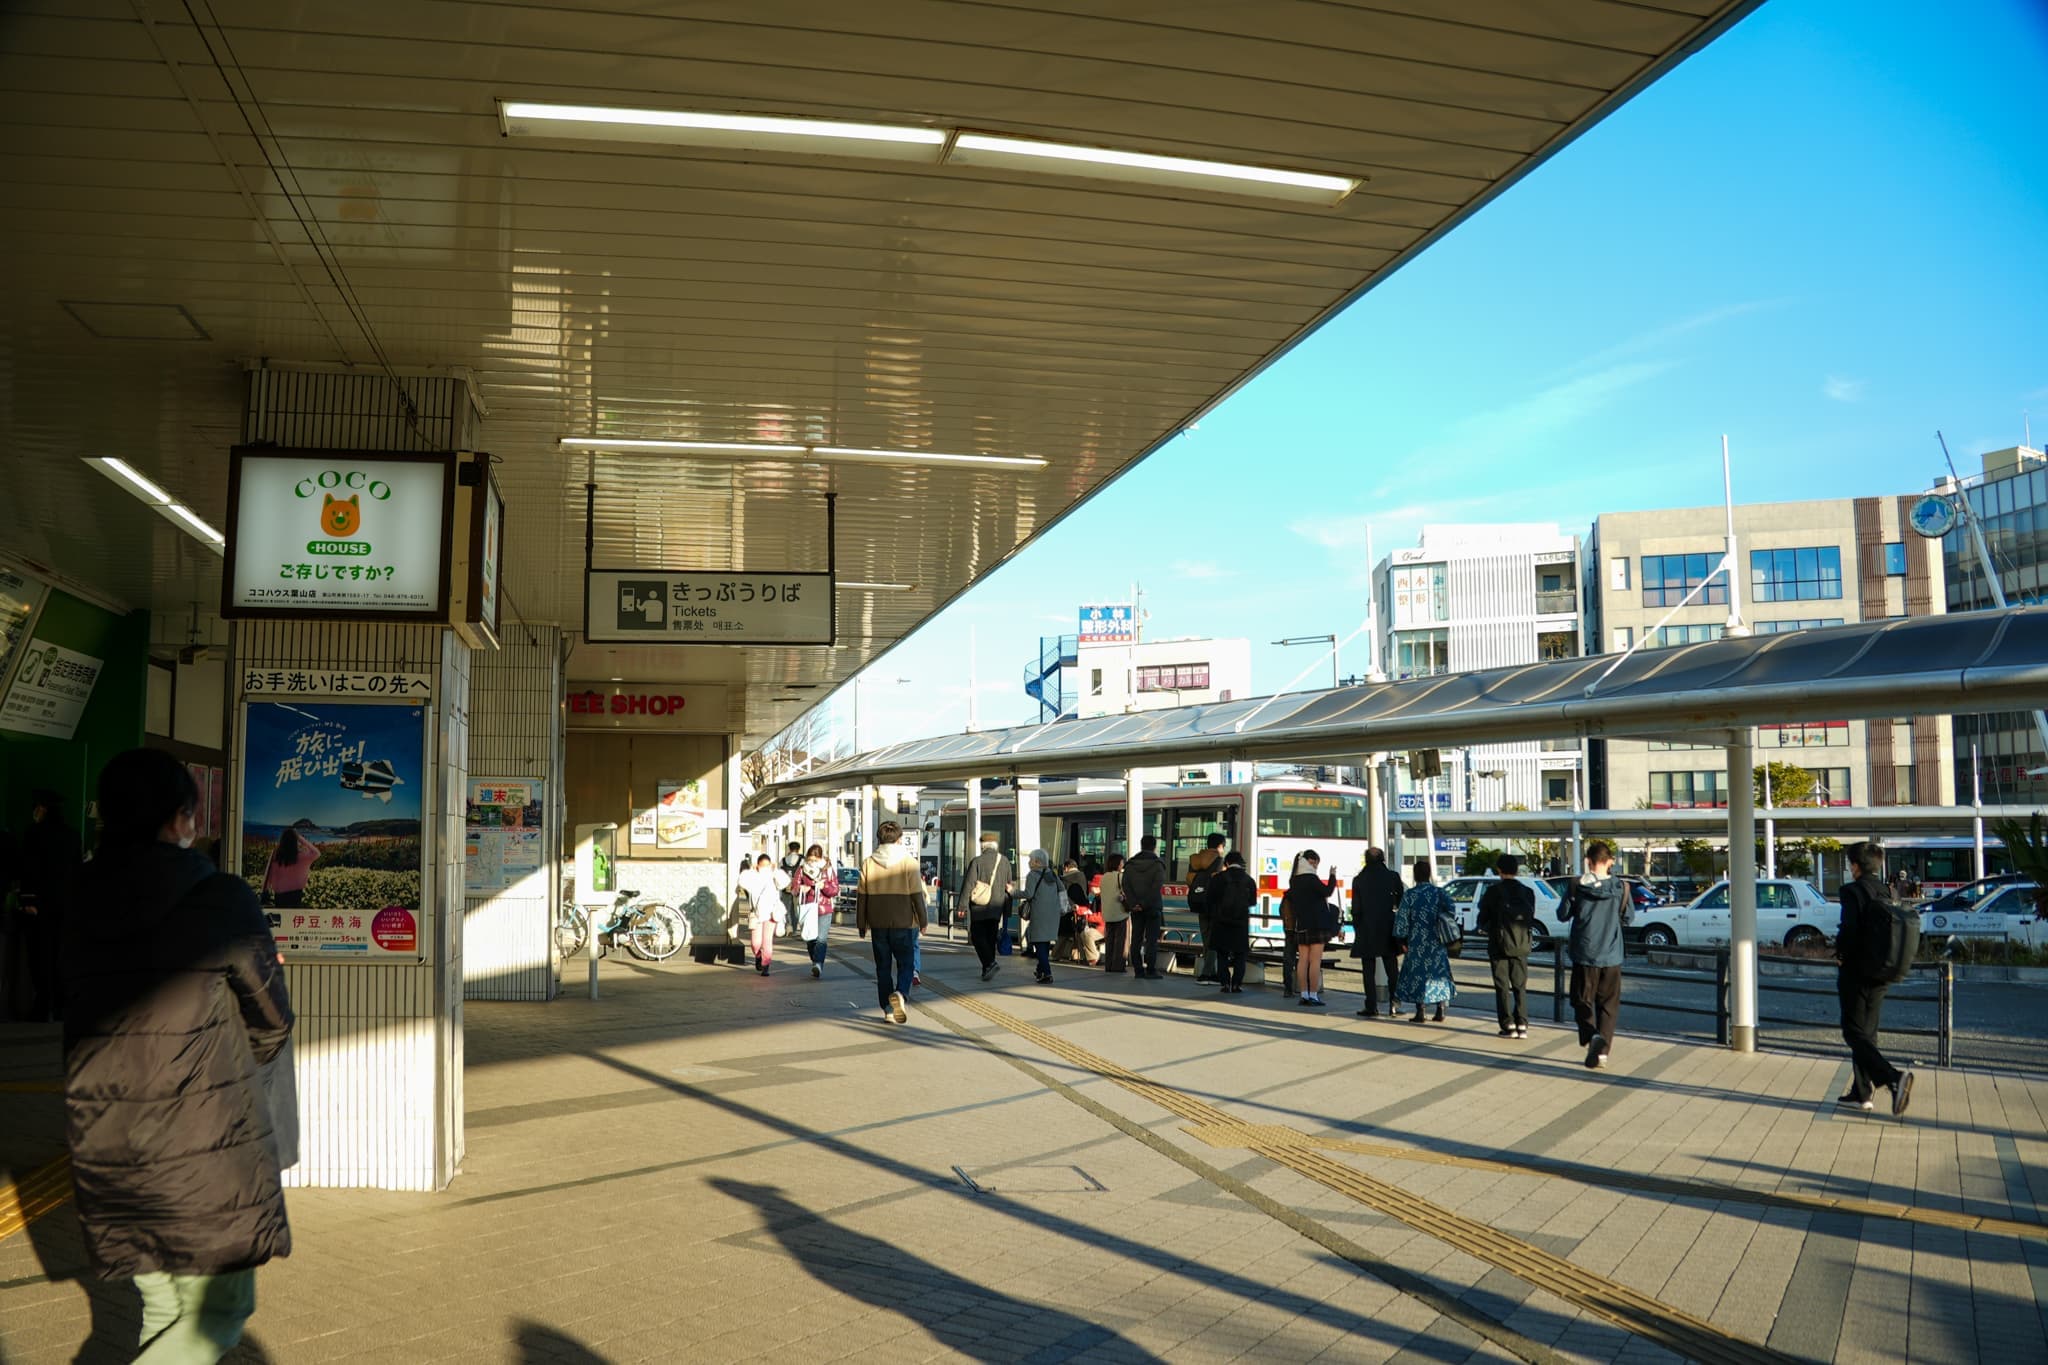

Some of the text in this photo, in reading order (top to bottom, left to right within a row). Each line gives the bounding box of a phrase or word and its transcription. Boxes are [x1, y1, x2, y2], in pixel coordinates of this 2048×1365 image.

[295, 471, 391, 500] COCO
[315, 543, 367, 554] HOUSE
[280, 563, 394, 581] ご存じですか?
[249, 588, 317, 598] ココハウス葉山店
[672, 582, 801, 602] きっぷうりば
[672, 605, 717, 617] Tickets
[672, 620, 704, 631] 售票处
[713, 621, 744, 631] 매표소
[1081, 619, 1131, 634] 整形外科
[245, 672, 430, 694] お手洗いはこの先へ
[566, 694, 685, 715] EE SHOP
[296, 731, 343, 755] 旅に
[275, 740, 366, 789] 飛び出せ!
[292, 915, 362, 929] 伊豆・熱海
